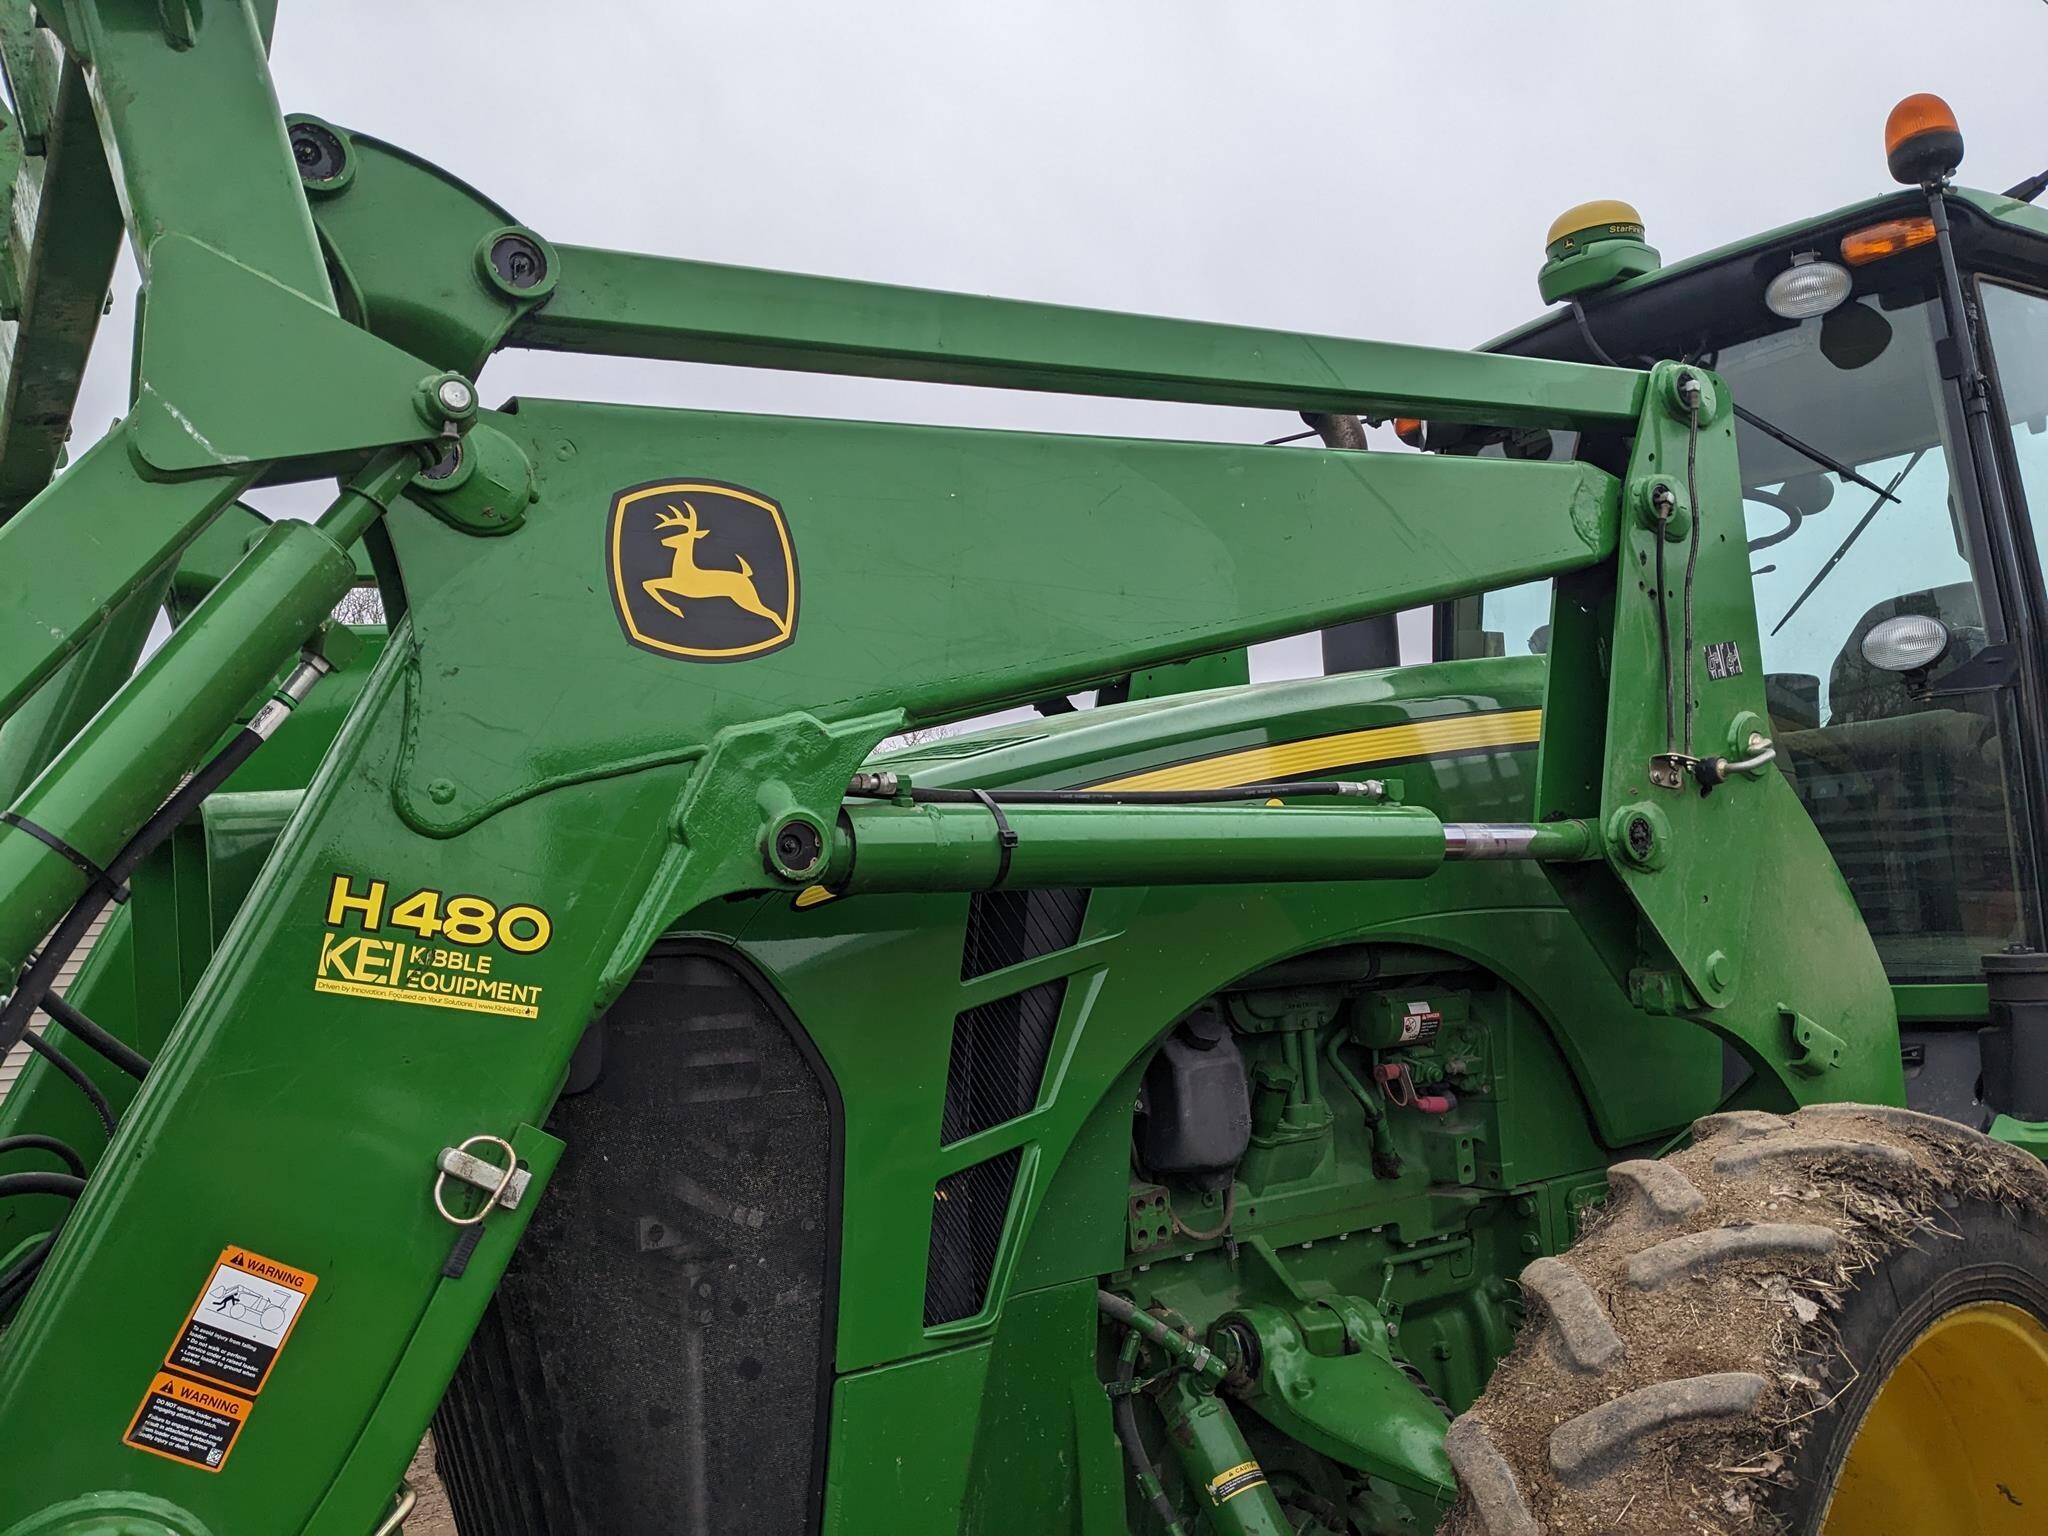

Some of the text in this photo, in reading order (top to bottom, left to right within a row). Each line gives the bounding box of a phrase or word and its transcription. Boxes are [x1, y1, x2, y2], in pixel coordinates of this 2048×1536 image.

[317, 932, 405, 985] KEI
[318, 981, 341, 991] Driven
[341, 985, 351, 993] by
[388, 990, 417, 1001] Focused
[426, 995, 443, 1004] Your
[407, 970, 543, 1004] EQUIPMENT
[247, 1258, 305, 1287] WARNING
[198, 1340, 208, 1348] not
[208, 1344, 220, 1353] walk
[226, 1350, 247, 1362] perform
[200, 1327, 214, 1337] avoid
[214, 1332, 228, 1342] injury
[229, 1337, 241, 1346] from
[241, 1342, 257, 1353] falling
[184, 1350, 200, 1359] Lower
[200, 1355, 217, 1365] loader
[223, 1364, 242, 1374] ground
[242, 1370, 256, 1378] when
[188, 1344, 206, 1354] service
[206, 1350, 222, 1360] under
[226, 1357, 243, 1367] raised
[181, 1386, 239, 1414] WARNING
[153, 1405, 176, 1417] engaging
[176, 1411, 204, 1424] attachment
[165, 1401, 177, 1409] NOT
[177, 1405, 196, 1416] operate
[196, 1410, 212, 1420] loader
[212, 1416, 230, 1427] without
[148, 1413, 165, 1423] Failure
[171, 1421, 189, 1431] engage
[189, 1426, 208, 1436] retainer
[208, 1433, 223, 1442] could
[154, 1428, 170, 1438] loader
[170, 1435, 189, 1445] causing
[189, 1439, 208, 1451] serious
[165, 1426, 193, 1439] attachment
[193, 1434, 217, 1447] detaching
[154, 1436, 168, 1446] injury
